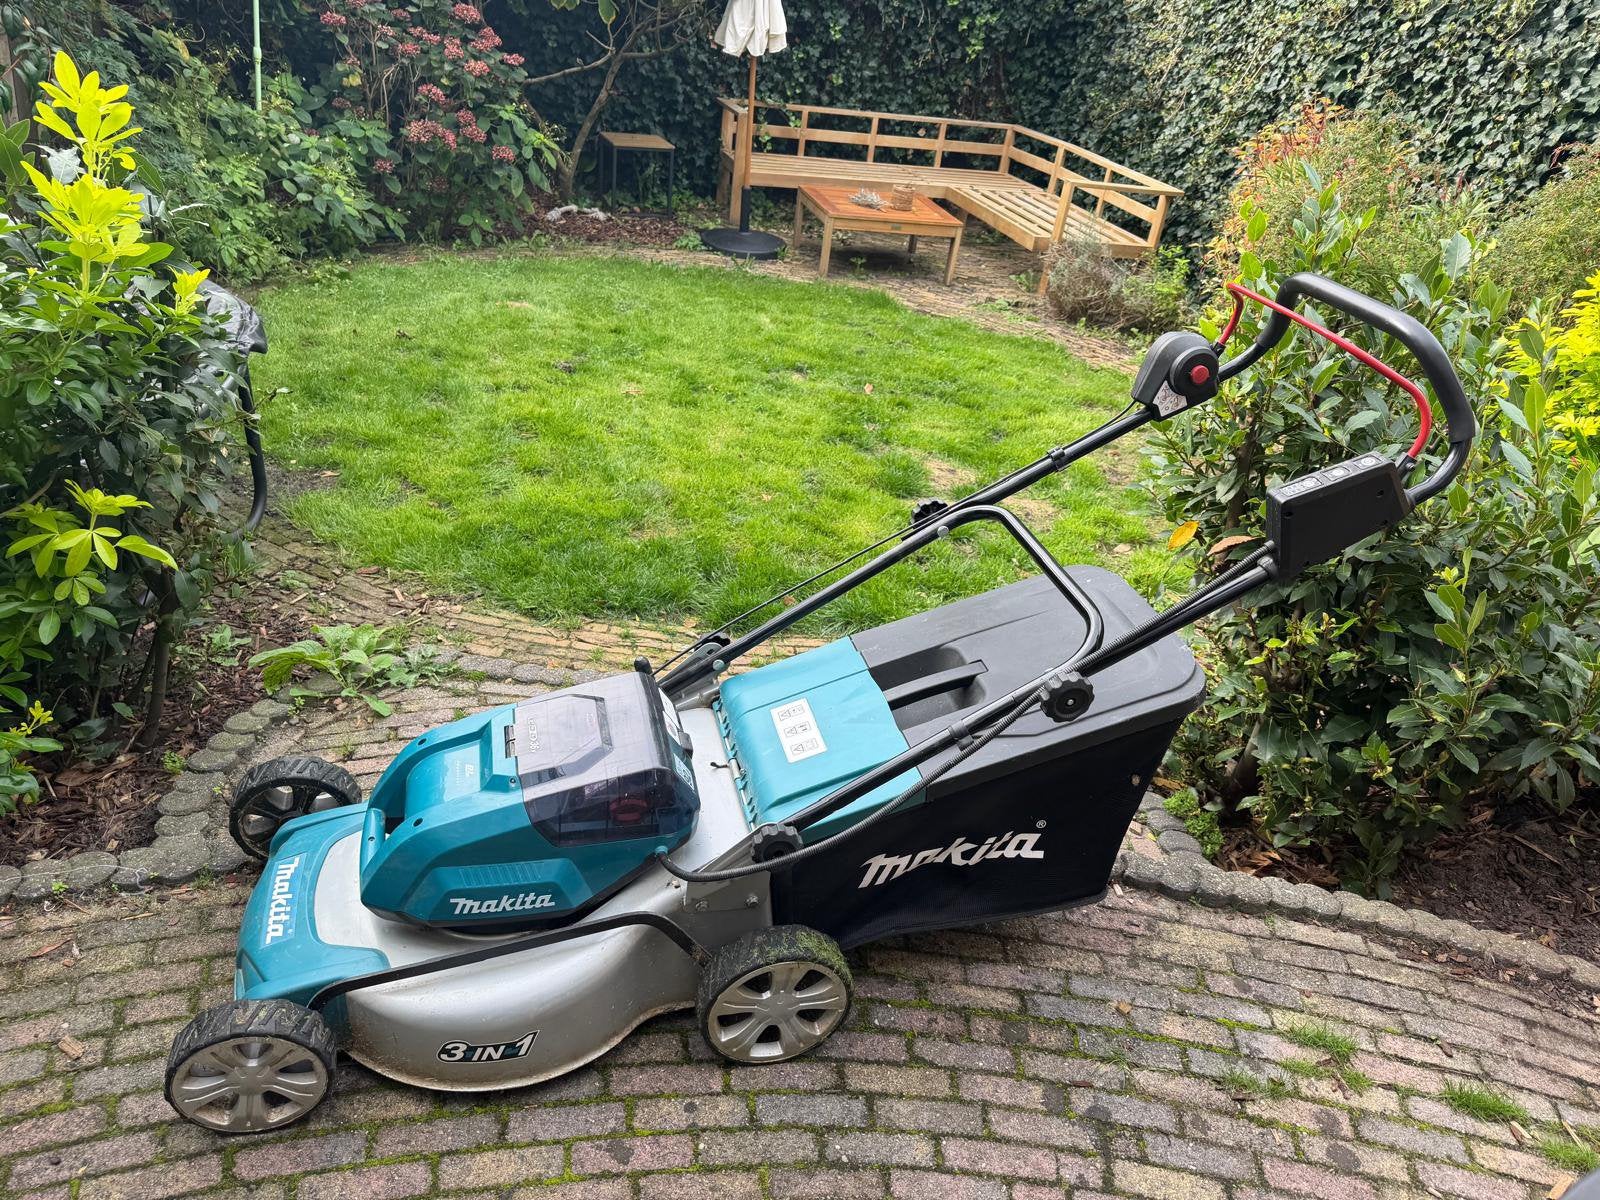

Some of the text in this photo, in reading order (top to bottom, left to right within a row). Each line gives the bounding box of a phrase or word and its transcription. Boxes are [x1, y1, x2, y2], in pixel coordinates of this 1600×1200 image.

[440, 1034, 535, 1061] 3 IN 1
